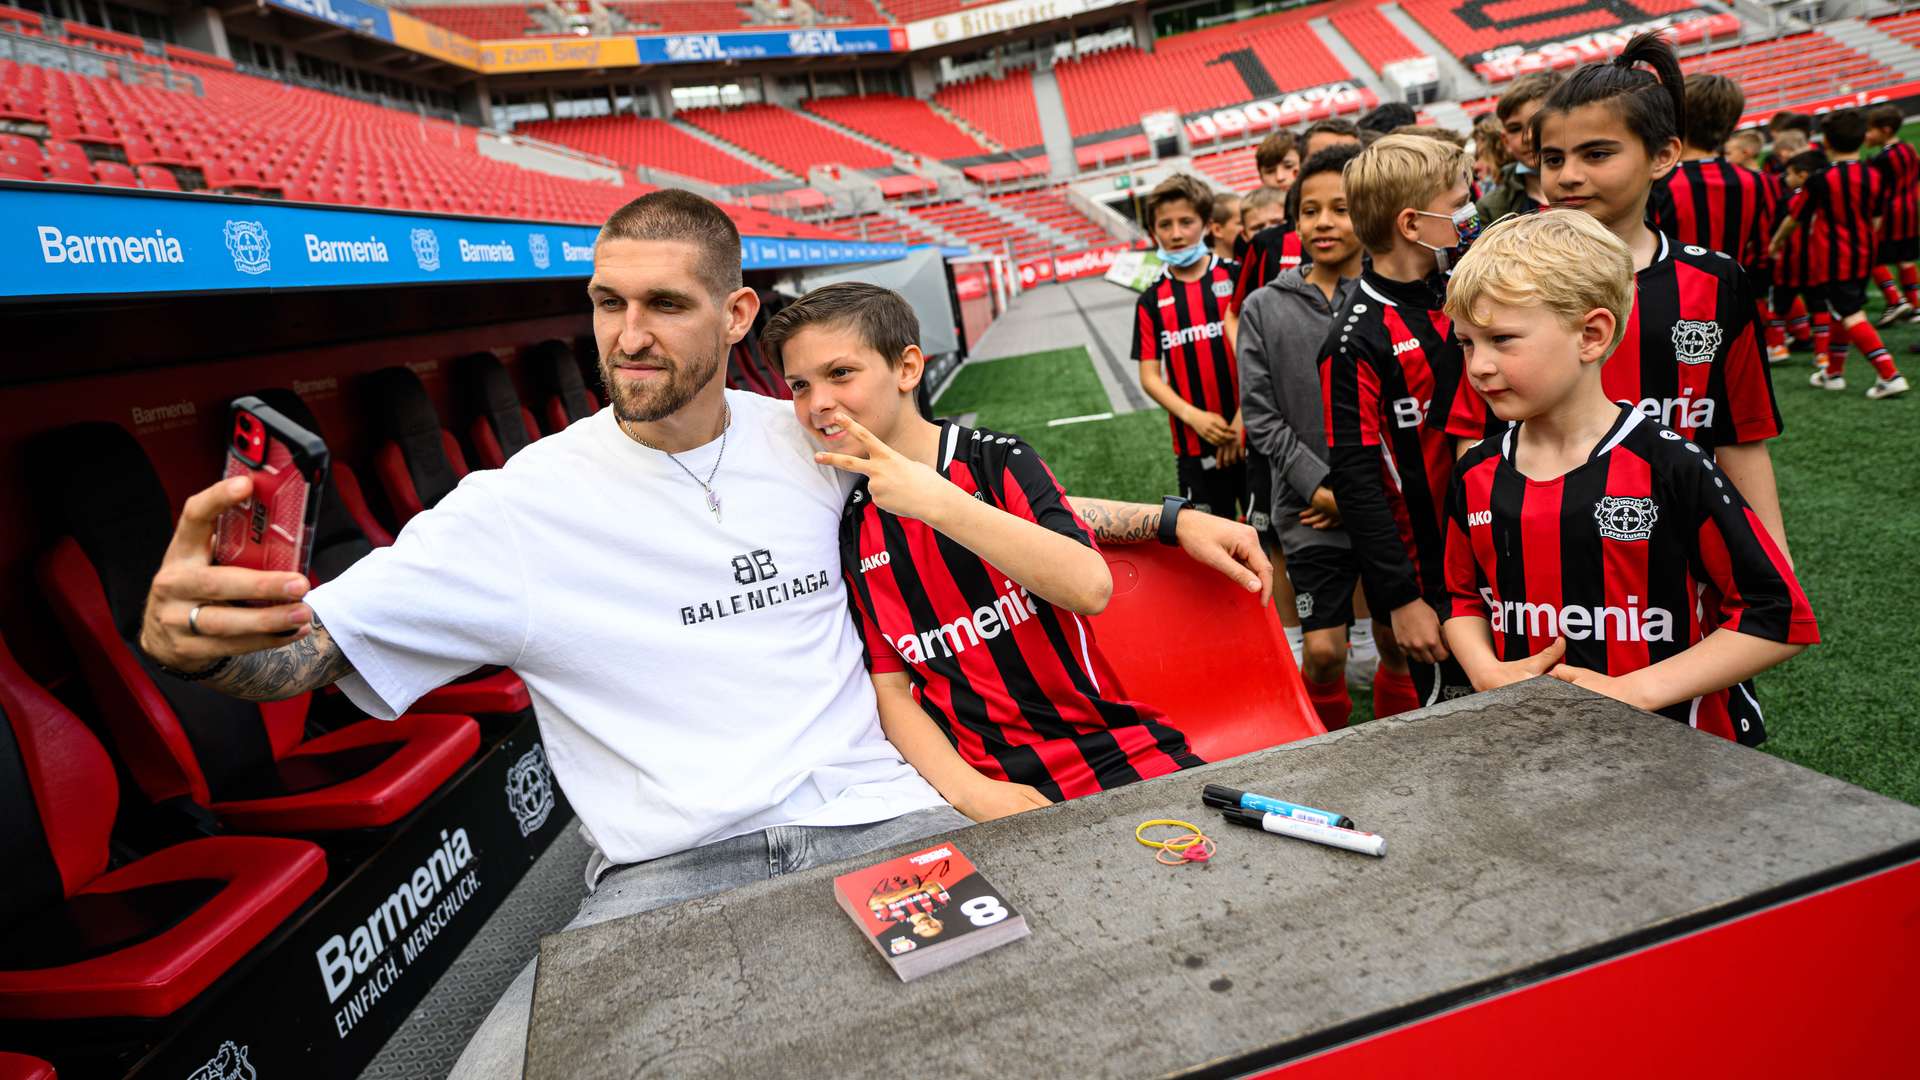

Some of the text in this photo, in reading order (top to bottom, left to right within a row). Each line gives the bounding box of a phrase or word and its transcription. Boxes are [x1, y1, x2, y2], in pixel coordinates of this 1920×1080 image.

[38, 226, 184, 264] Barmenia
[304, 233, 389, 263] Barmenia
[459, 238, 515, 262] Barmenia
[562, 241, 597, 262] Barme
[1393, 337, 1420, 356] JAKO
[131, 400, 197, 425] Barmenia
[1637, 387, 1716, 428] enia
[1467, 510, 1493, 527] AKO
[1604, 529, 1647, 540] Leverkusen
[860, 550, 891, 573] JAKO
[680, 570, 829, 626] BALENCIAGA
[882, 580, 1038, 664] armeni
[315, 827, 475, 1004] Barmenia
[960, 895, 1009, 927] 8
[335, 870, 482, 1039] EINFACH. MENSCHLICH.
